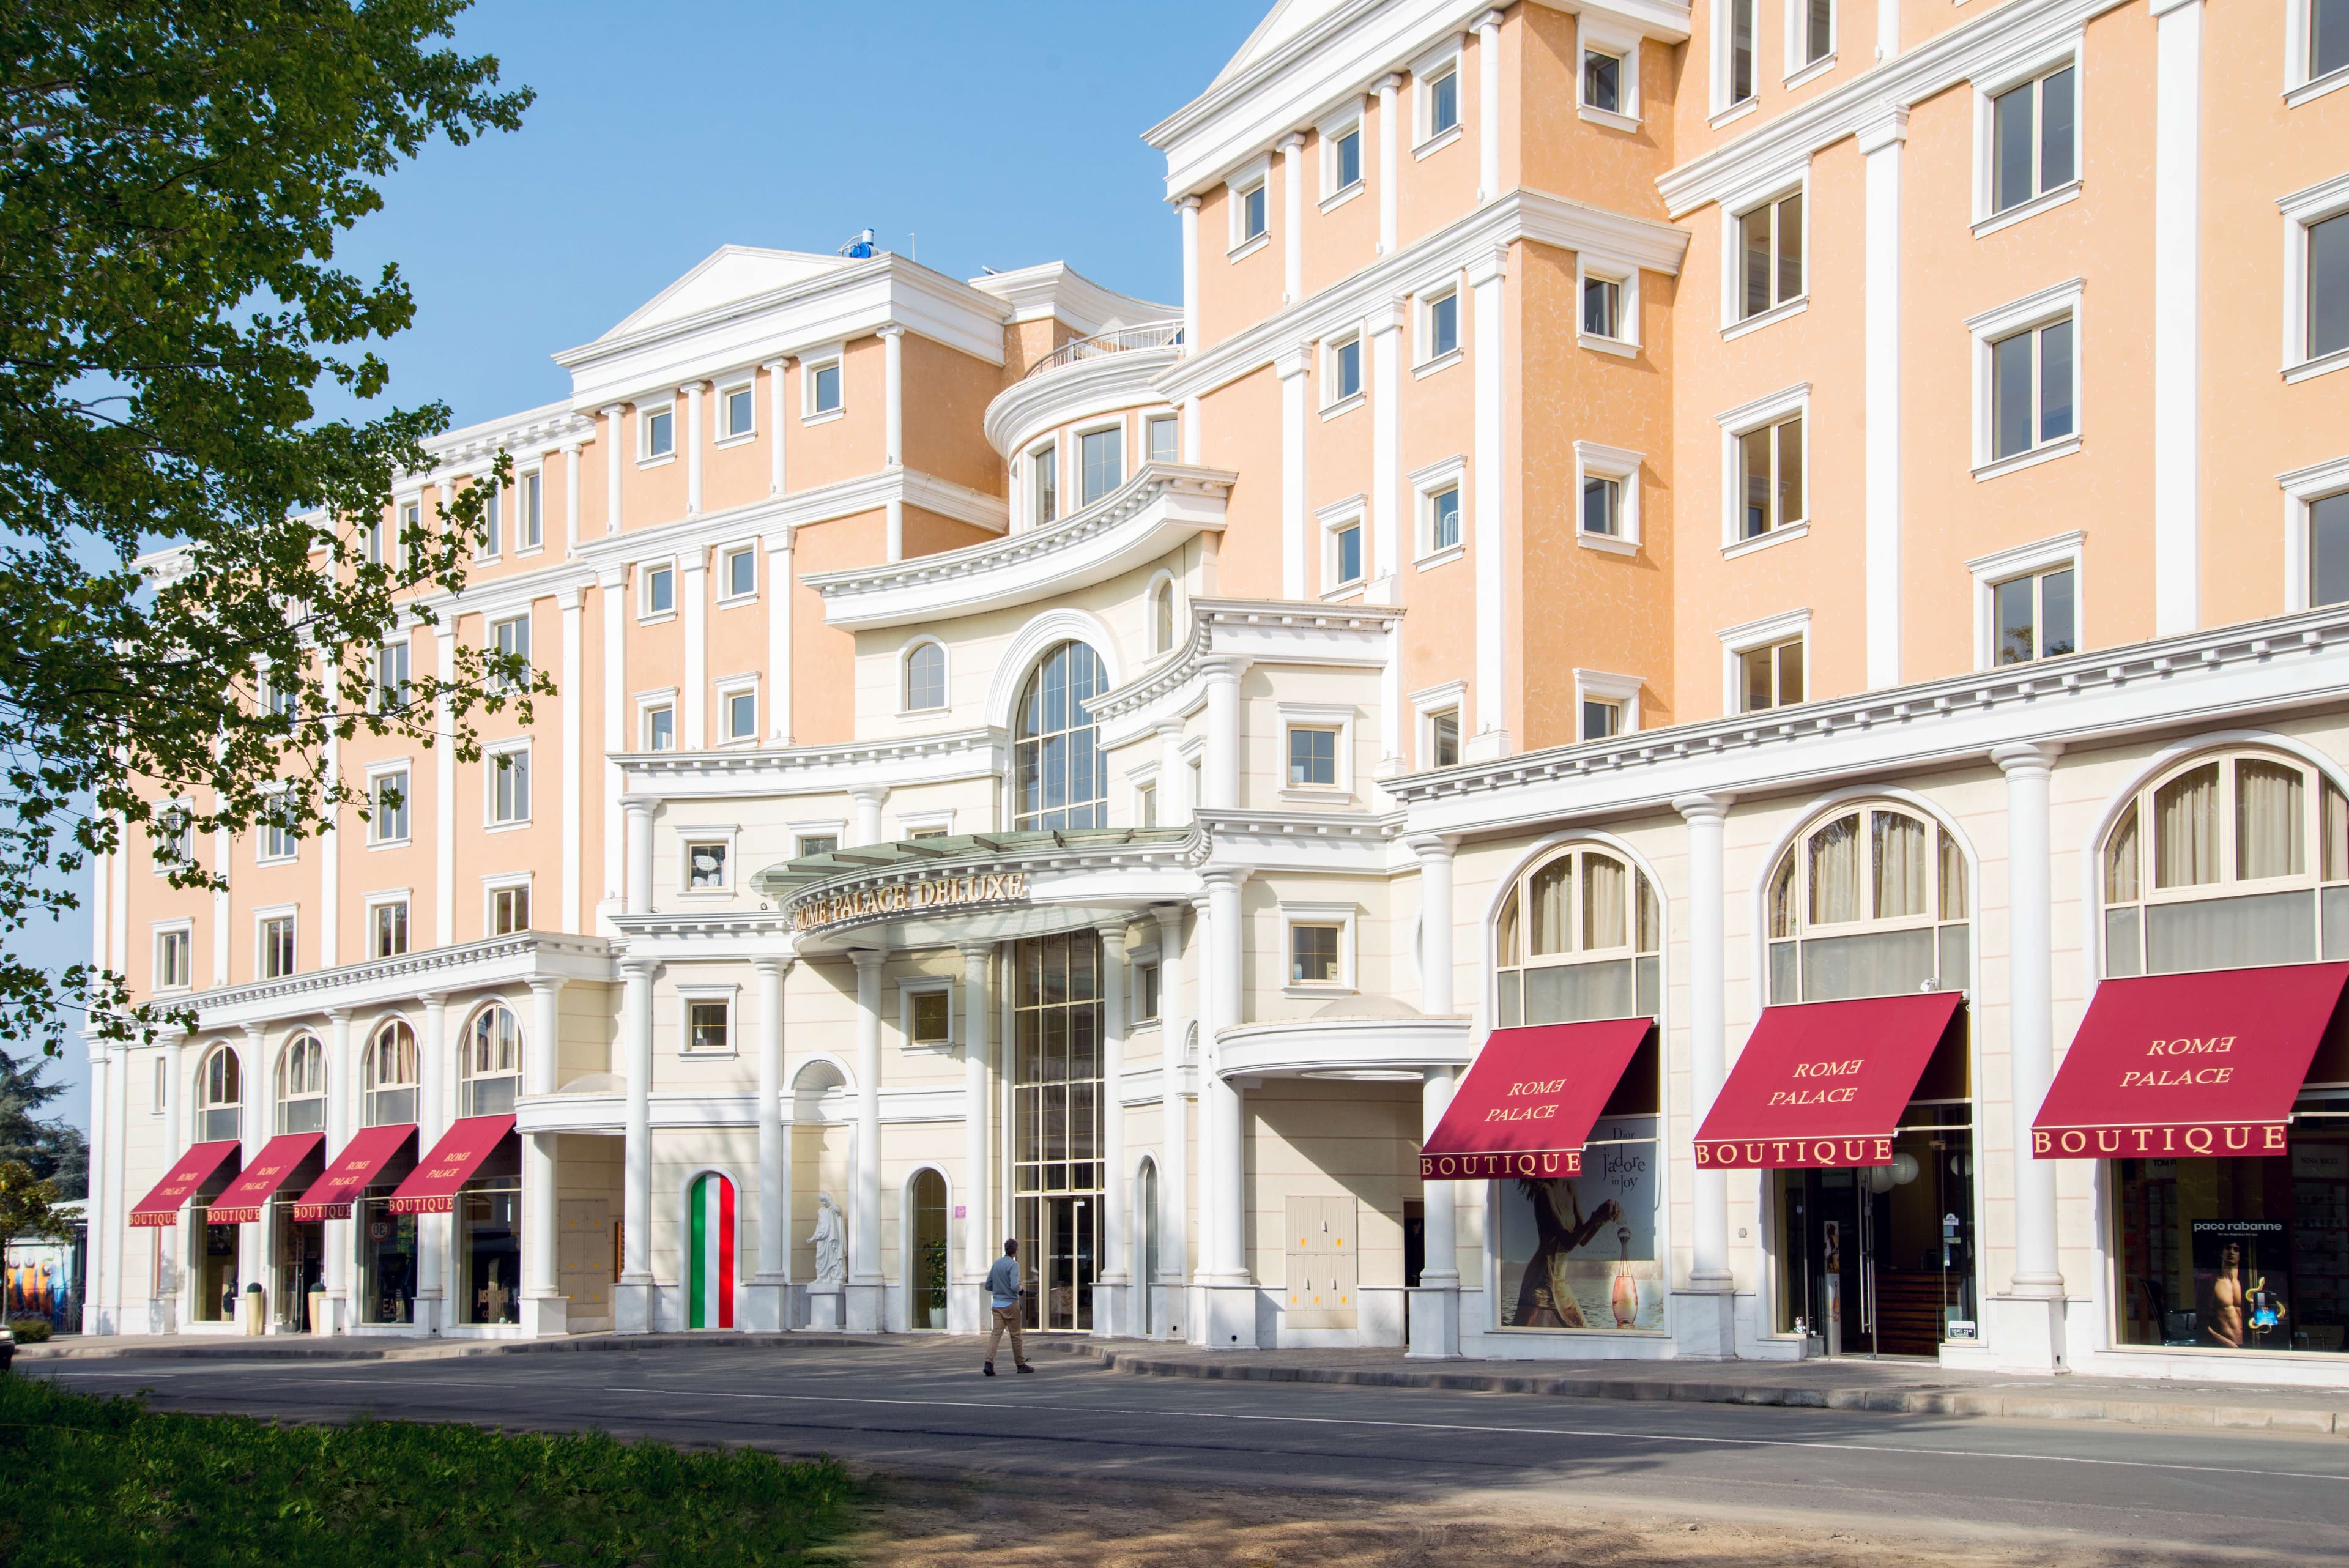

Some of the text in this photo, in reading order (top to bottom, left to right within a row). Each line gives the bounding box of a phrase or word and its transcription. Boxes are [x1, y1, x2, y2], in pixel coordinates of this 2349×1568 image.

[795, 872, 1026, 932] ROME PALACE DELUXE
[2119, 1068, 2234, 1087] PALACE
[1767, 1087, 1858, 1105] PALACE
[1484, 1104, 1559, 1121] PALACE
[1612, 1127, 1635, 1139] Dior
[2034, 1126, 2285, 1154] BOUTIQUE
[1696, 1139, 1891, 1167] BOUTIQUE
[426, 1168, 460, 1178] PALACE
[1421, 1153, 1581, 1178] BOUTIQUE
[240, 1181, 269, 1191] PALACE
[328, 1176, 359, 1186] PALACE
[1611, 1170, 1638, 1196] in joy
[160, 1186, 187, 1196] PALACE
[294, 1204, 351, 1220] BOUTIQUE
[390, 1197, 453, 1213] BOUTIQUE
[129, 1213, 176, 1225] BOUTIQUE
[207, 1209, 260, 1222] BOUTIQUE
[2194, 1222, 2282, 1232] paco rabanne
